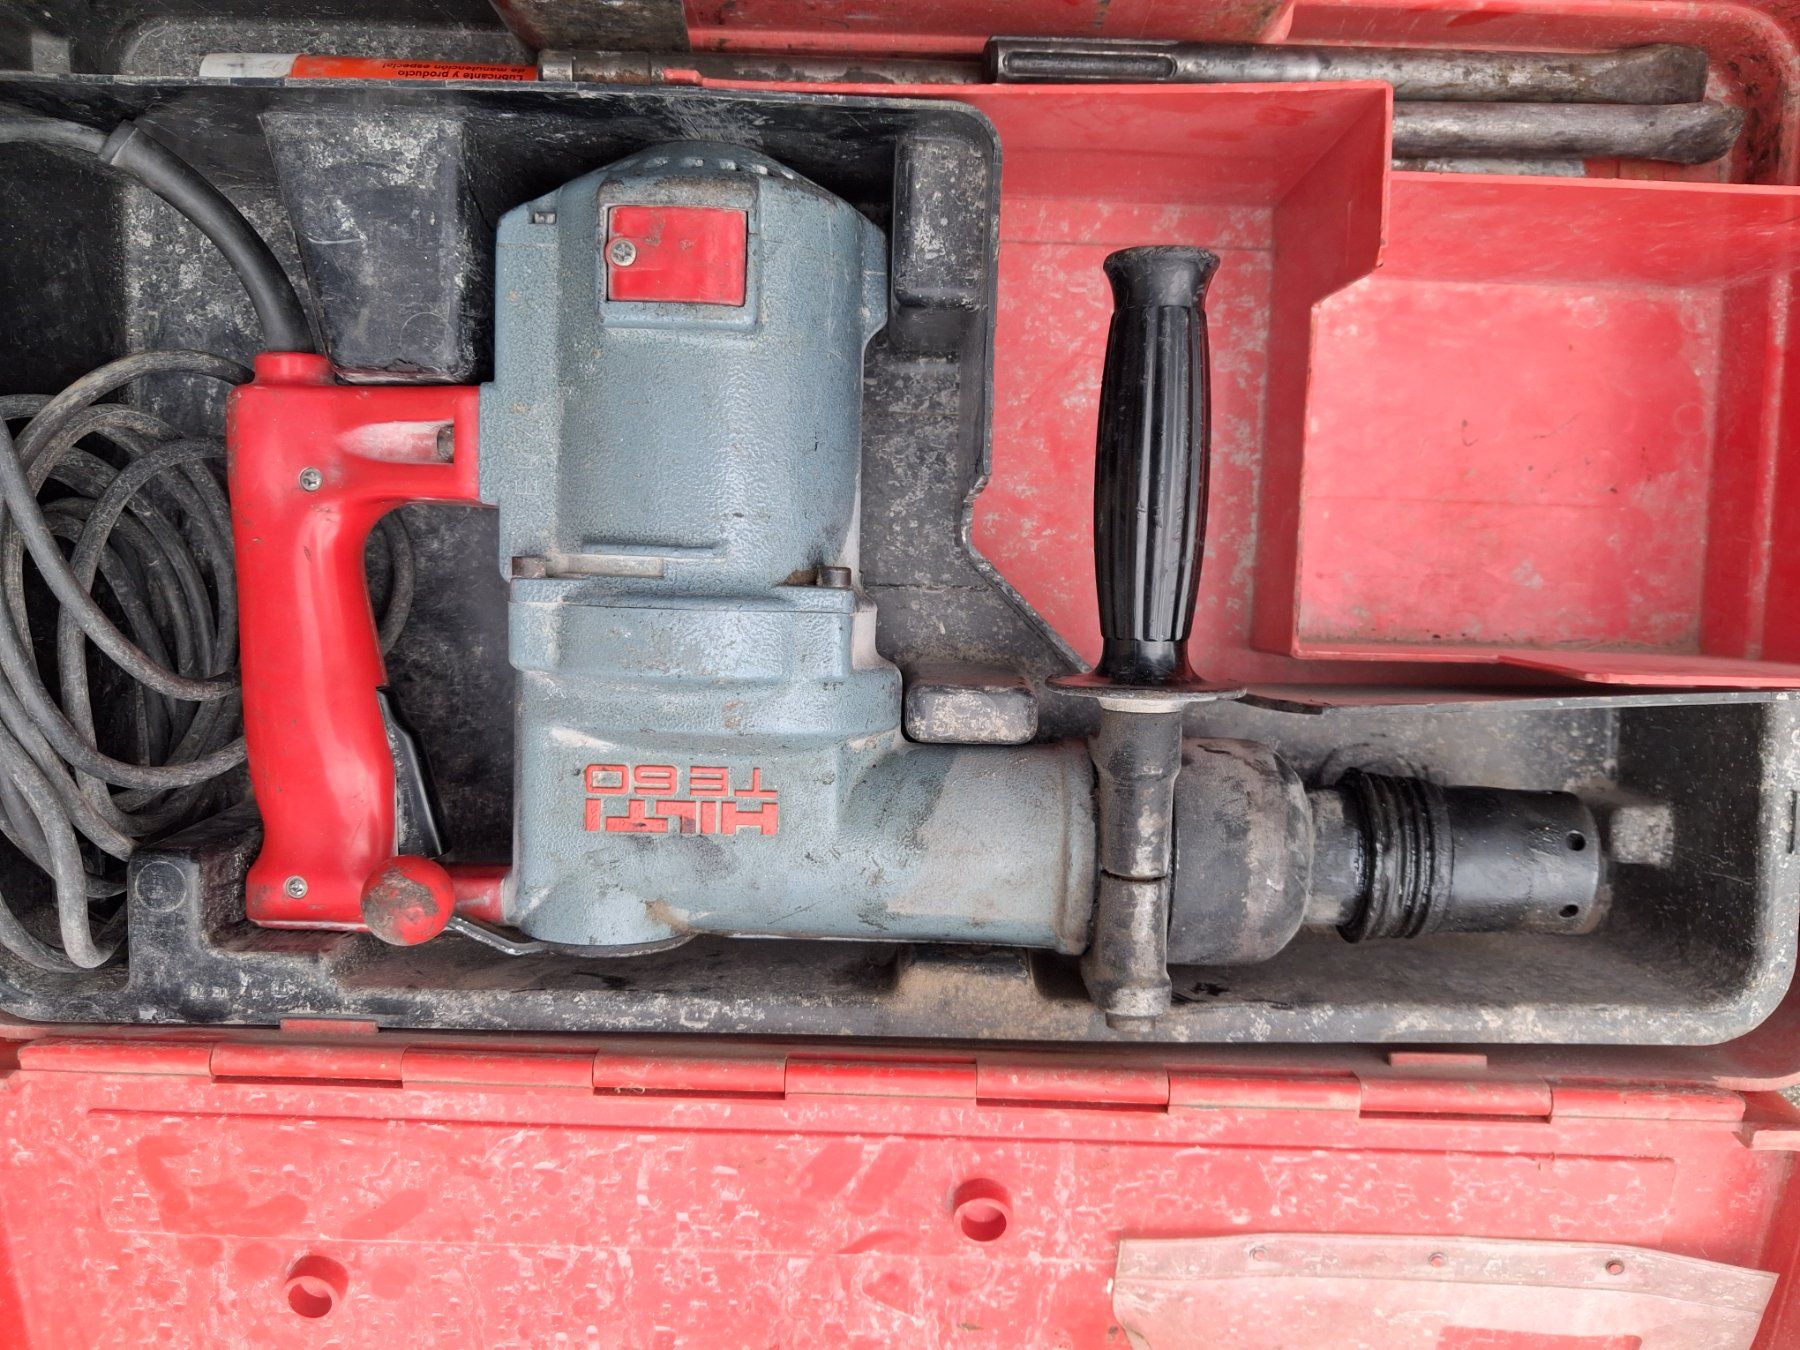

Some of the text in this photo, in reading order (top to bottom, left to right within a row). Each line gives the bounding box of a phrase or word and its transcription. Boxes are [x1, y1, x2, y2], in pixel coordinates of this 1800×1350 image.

[397, 70, 449, 78] producto
[463, 72, 523, 80] Lubricante
[585, 798, 778, 835] HILTI
